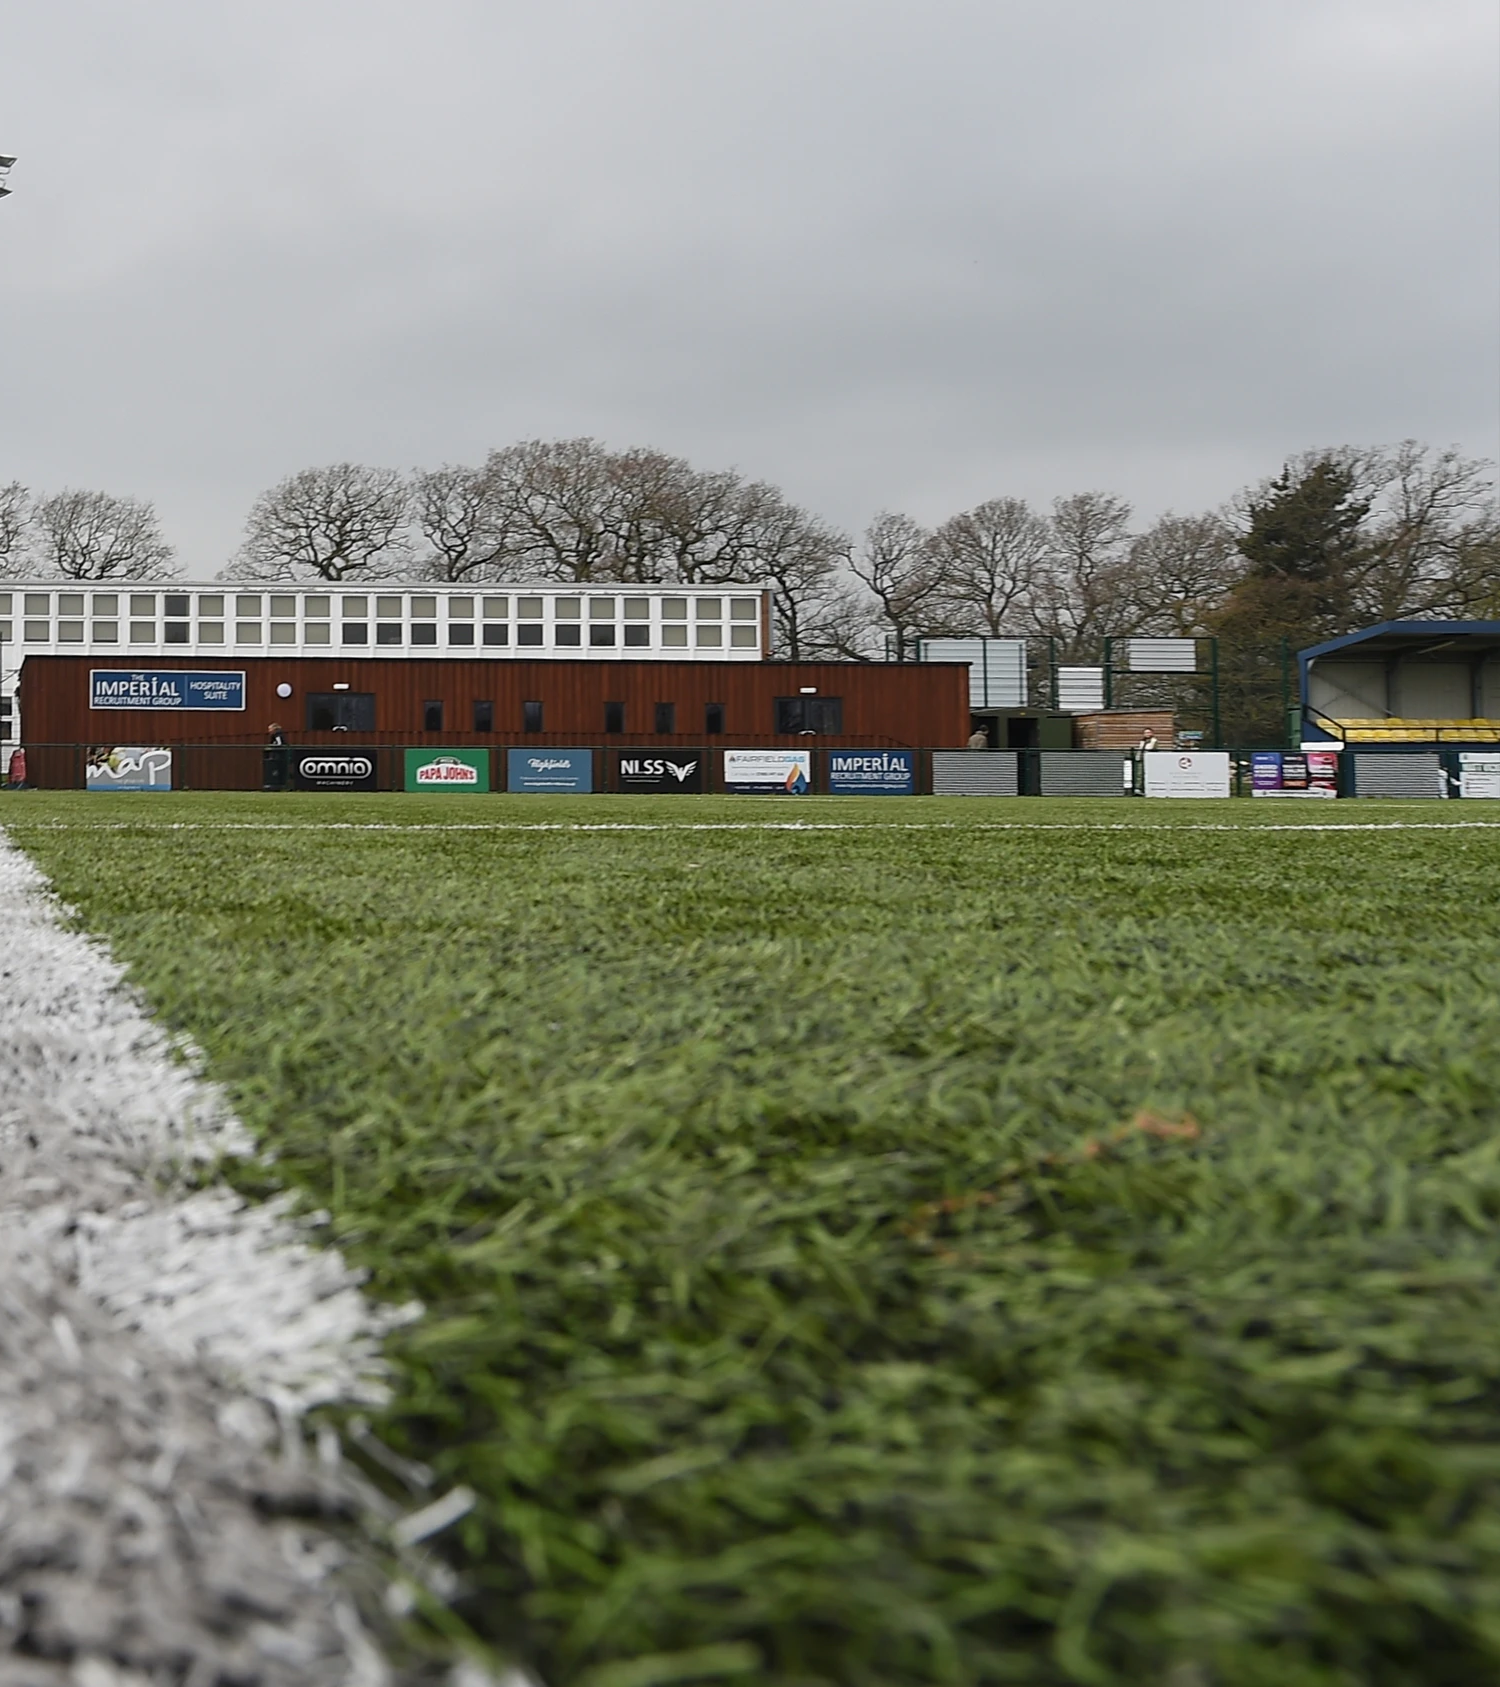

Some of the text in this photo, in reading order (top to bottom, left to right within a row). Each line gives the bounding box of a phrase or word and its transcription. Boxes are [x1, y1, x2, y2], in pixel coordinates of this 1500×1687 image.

[95, 677, 180, 696] IMPERIAL
[190, 681, 241, 691] HOSPITALITY
[94, 696, 182, 706] RECRUITMENT GROUP
[203, 691, 229, 700] SUITE
[86, 750, 172, 786] map
[620, 759, 664, 775] NLSS
[832, 752, 909, 771] IMPERIAL
[304, 762, 366, 775] omnia
[419, 767, 442, 780] PAPA
[830, 772, 912, 781] RECRUITMENT GROUP
